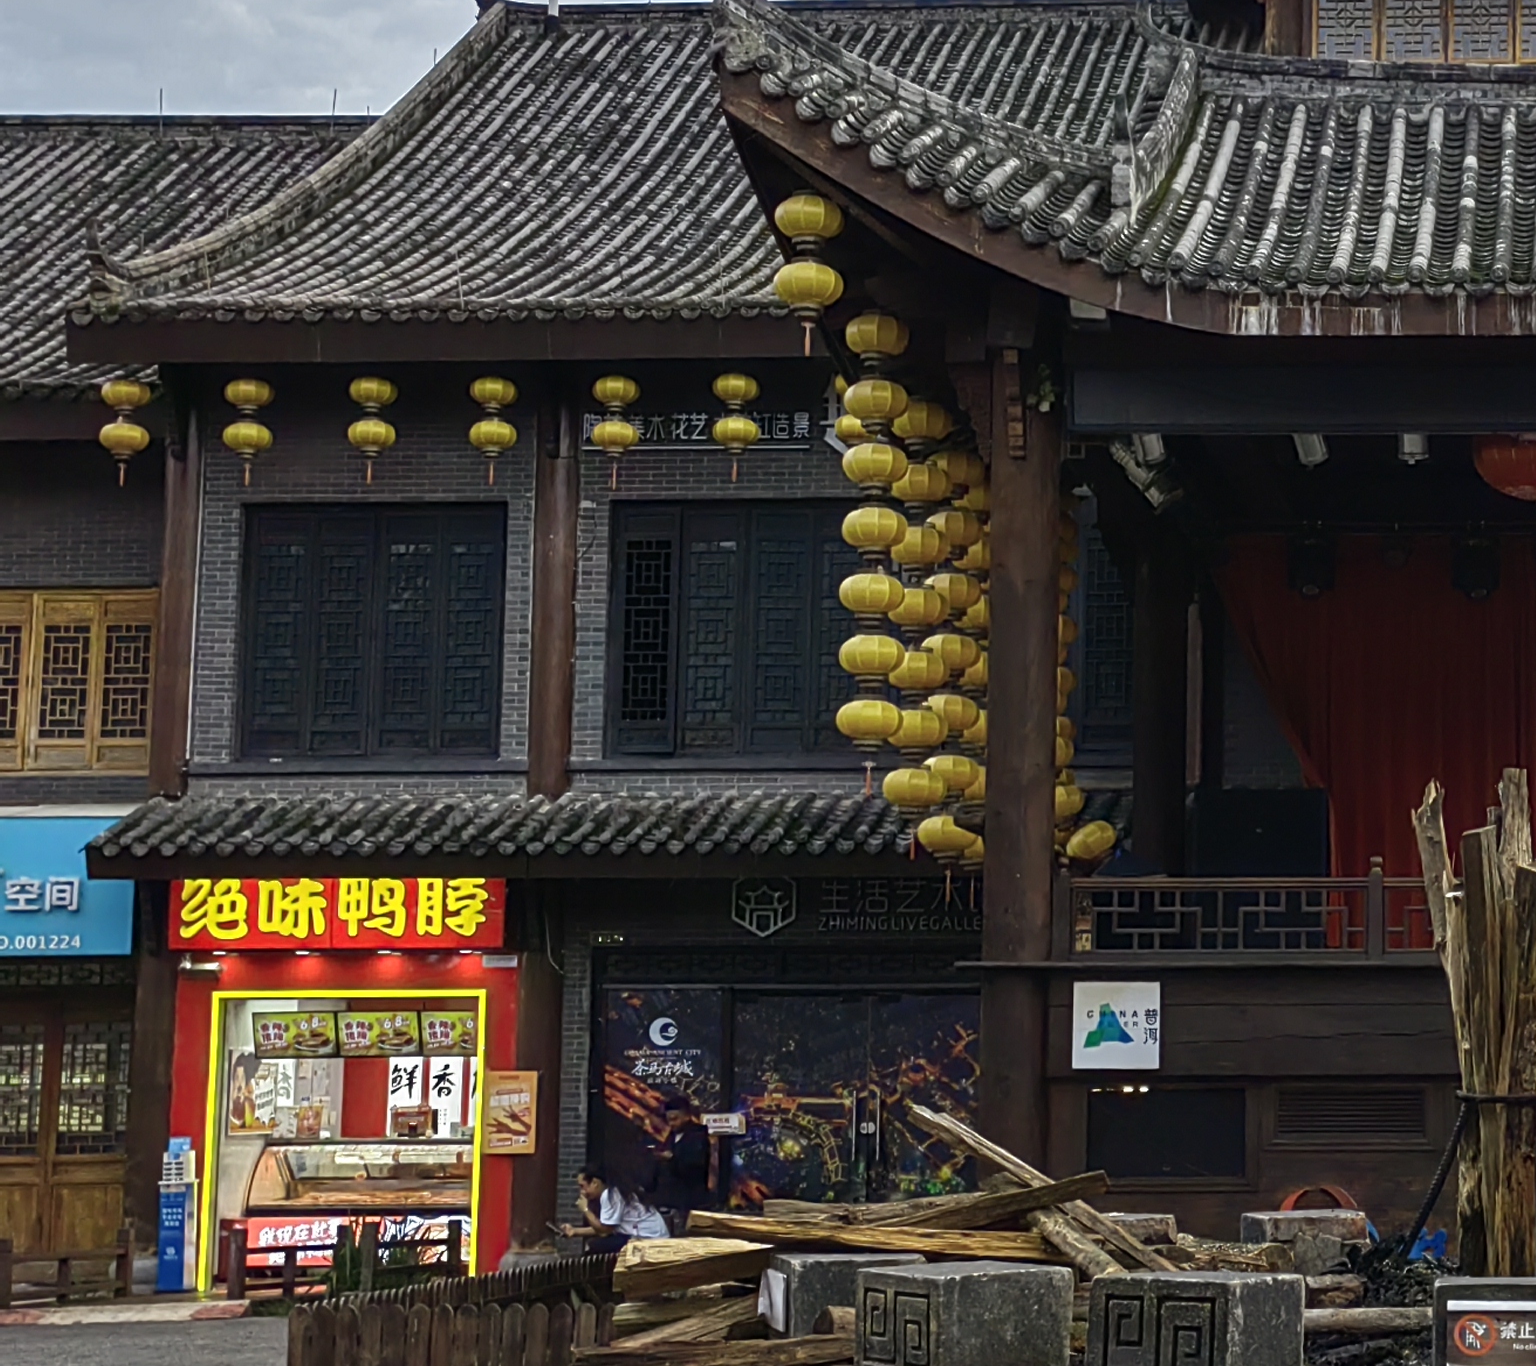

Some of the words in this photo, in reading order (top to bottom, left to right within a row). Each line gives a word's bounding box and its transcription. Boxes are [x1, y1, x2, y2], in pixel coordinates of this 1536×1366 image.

[5, 876, 81, 912] 空间
[179, 878, 489, 940] 绝味鸭脖
[390, 1063, 420, 1100] 鲜
[431, 1063, 457, 1099] 香
[1512, 1342, 1524, 1351] No
